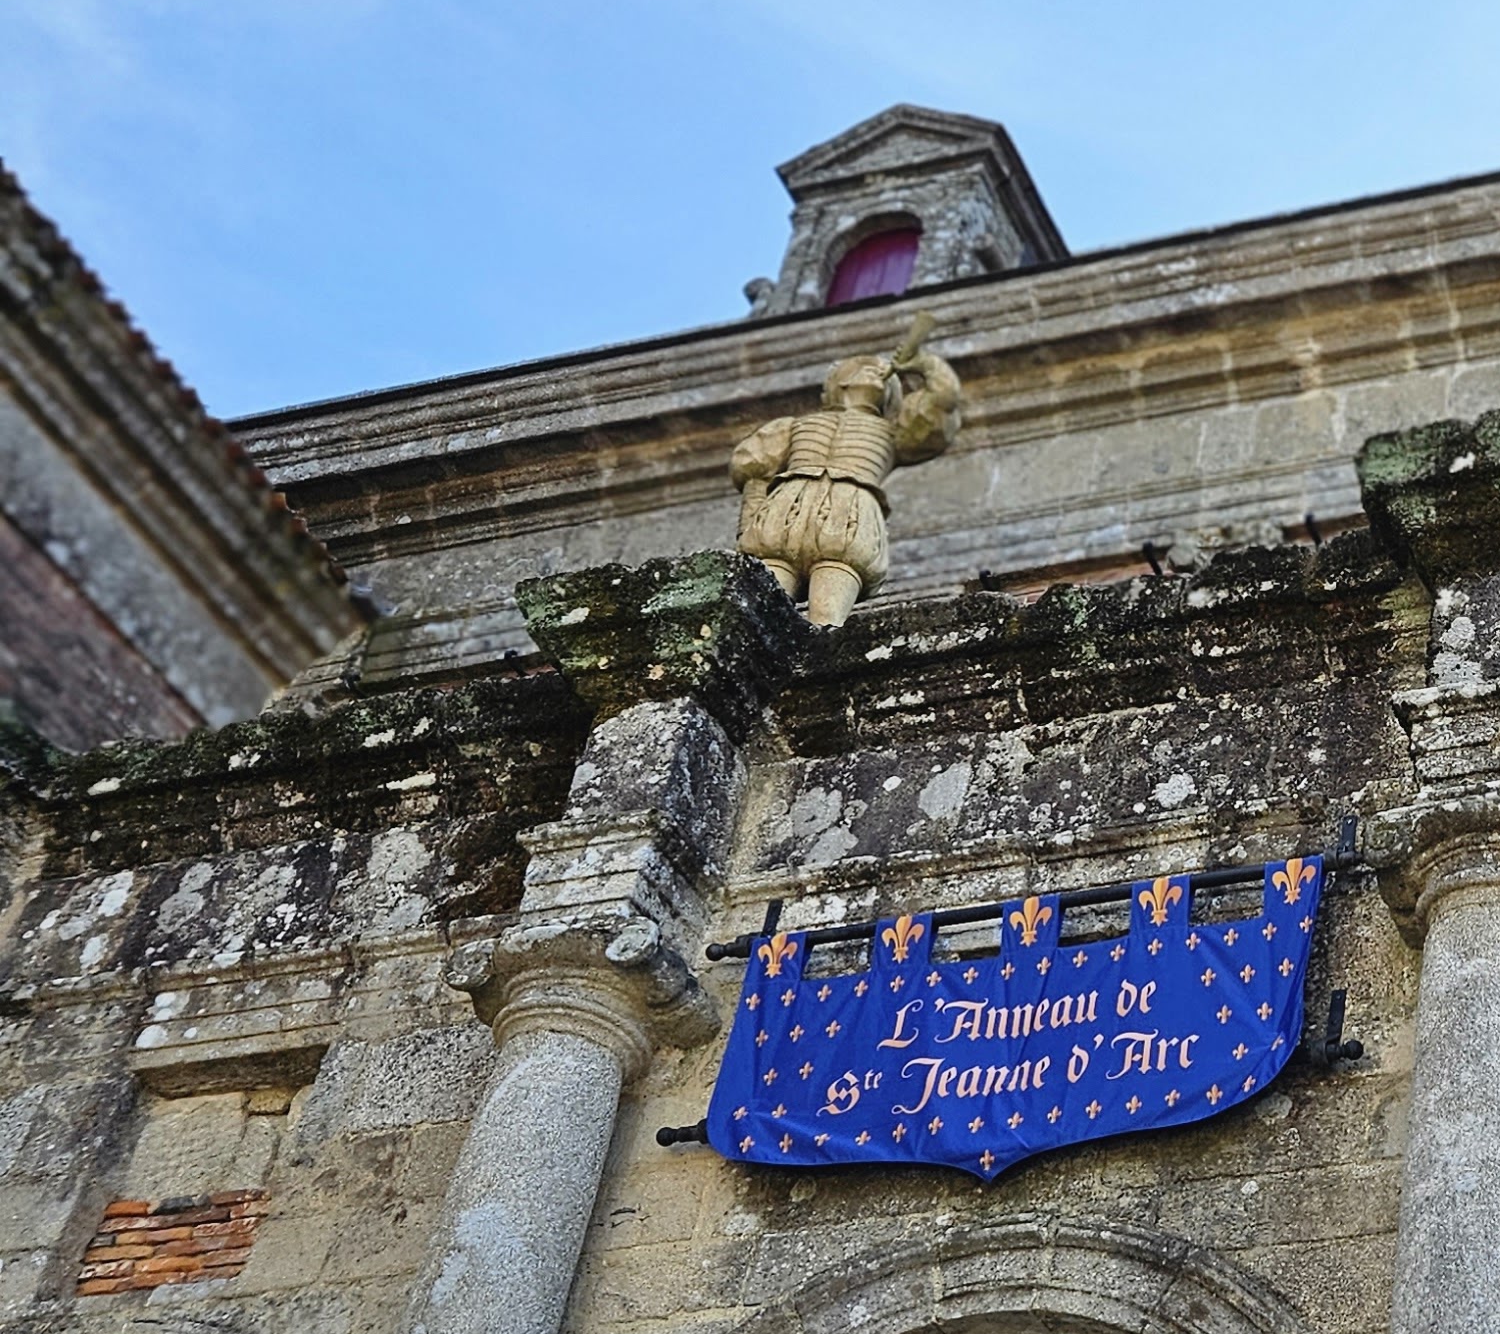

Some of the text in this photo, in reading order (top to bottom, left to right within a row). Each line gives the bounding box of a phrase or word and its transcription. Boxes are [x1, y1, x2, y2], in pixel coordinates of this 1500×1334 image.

[1115, 978, 1157, 1018] de
[816, 1068, 884, 1117] Ste
[890, 1055, 1052, 1115] Jeanne
